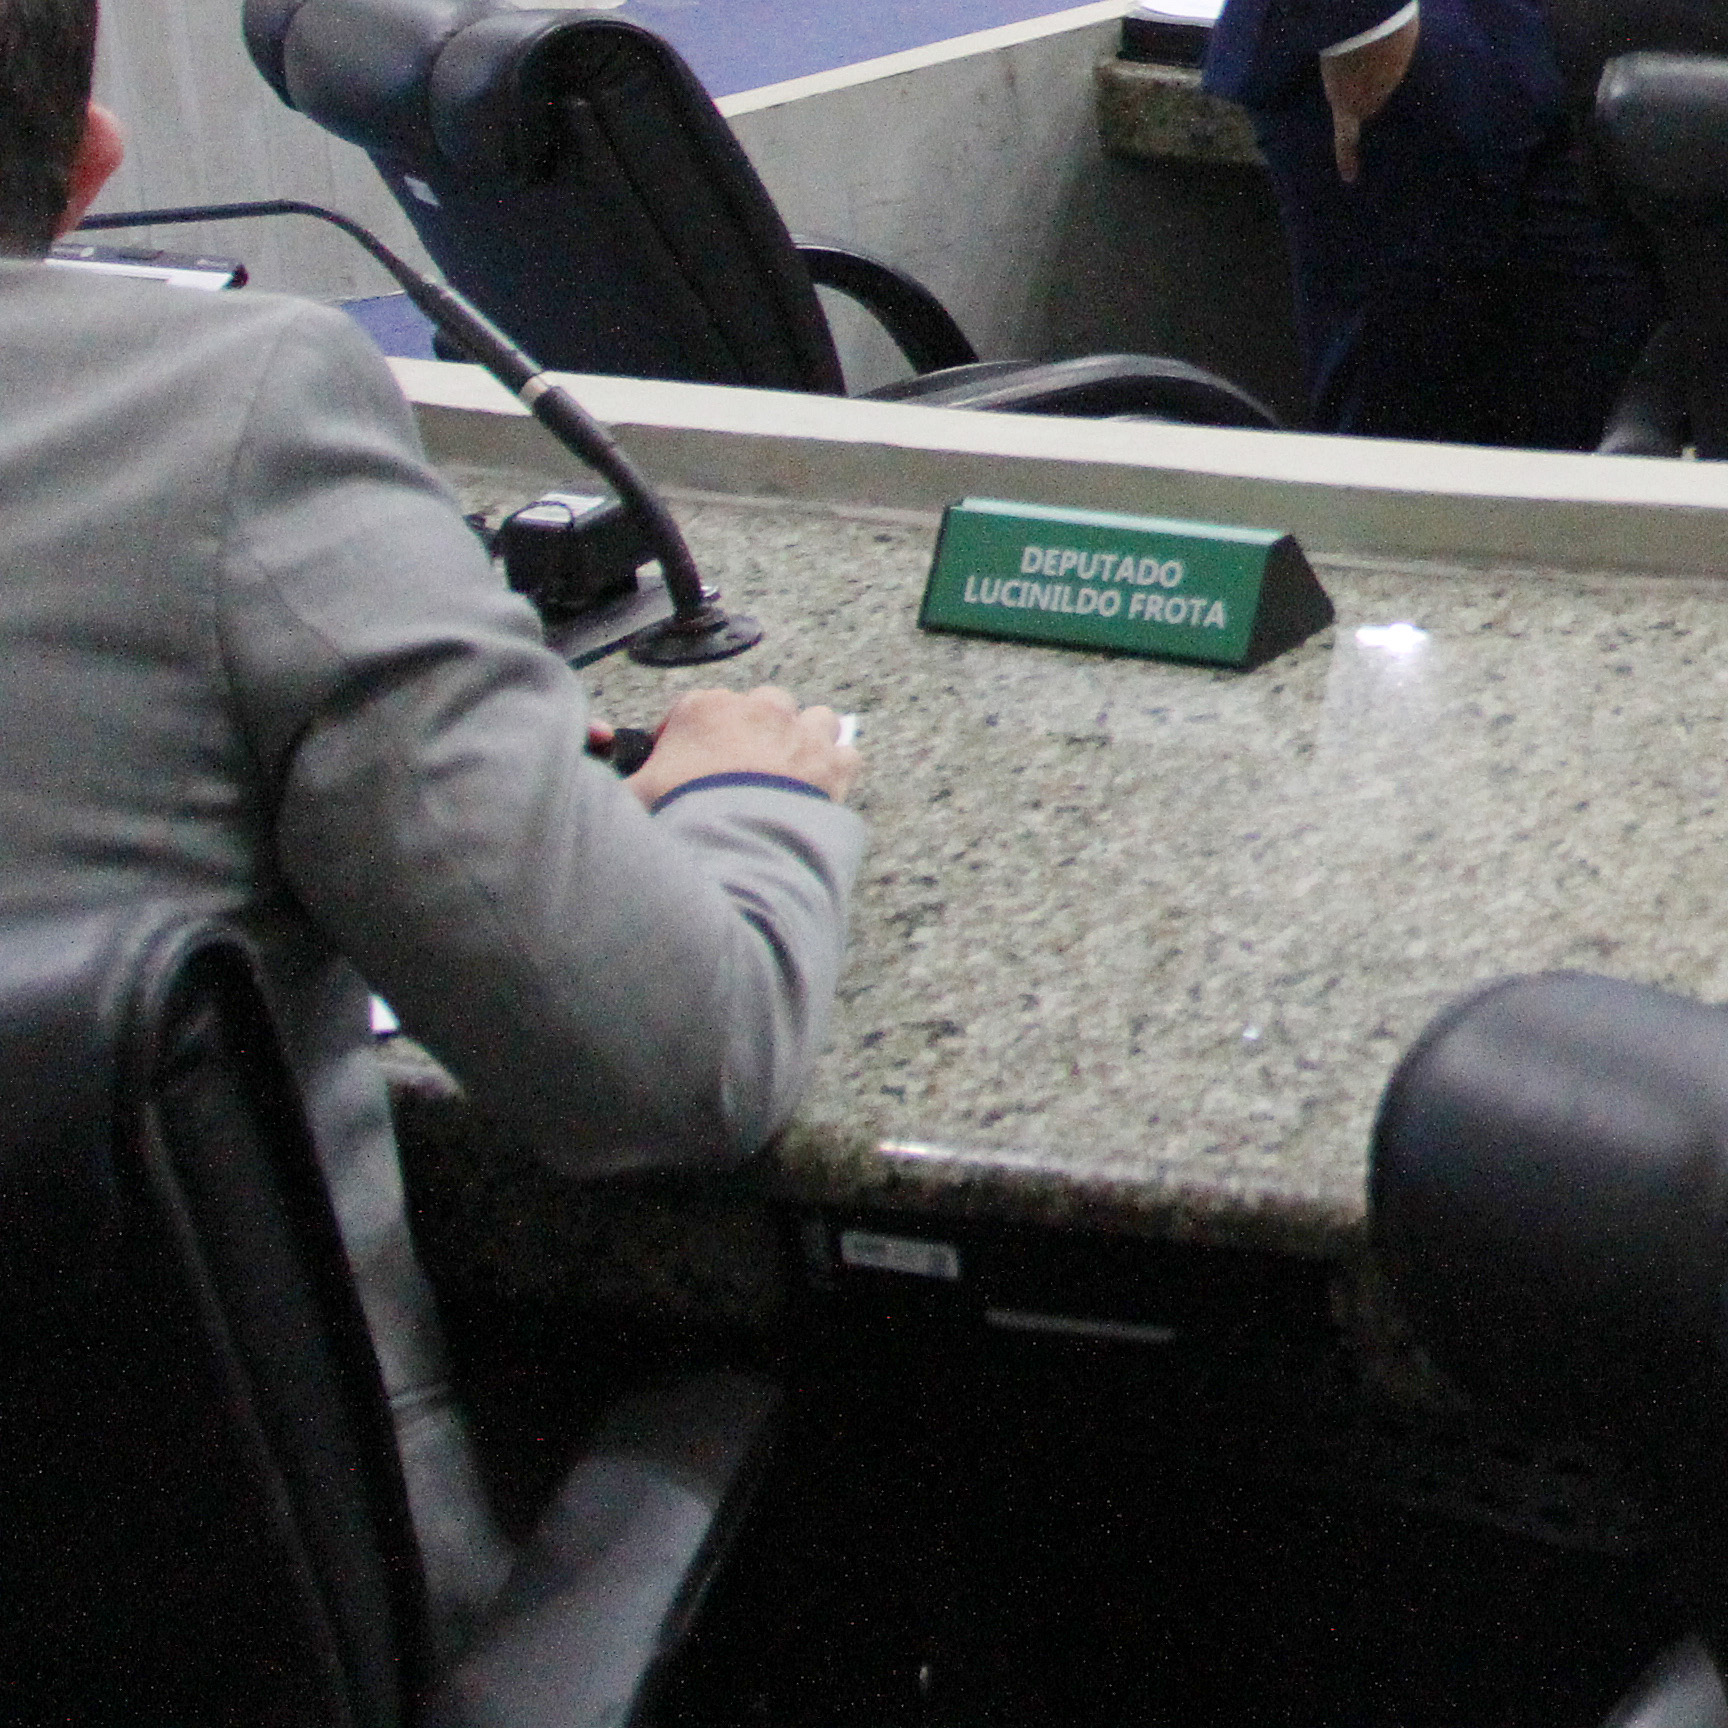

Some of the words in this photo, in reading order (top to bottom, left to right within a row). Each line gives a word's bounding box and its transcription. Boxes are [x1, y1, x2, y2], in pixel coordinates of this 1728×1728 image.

[1021, 546, 1184, 589] DEPUTADO
[964, 575, 1121, 618] LUCINILDO
[1128, 592, 1228, 630] FROTA
